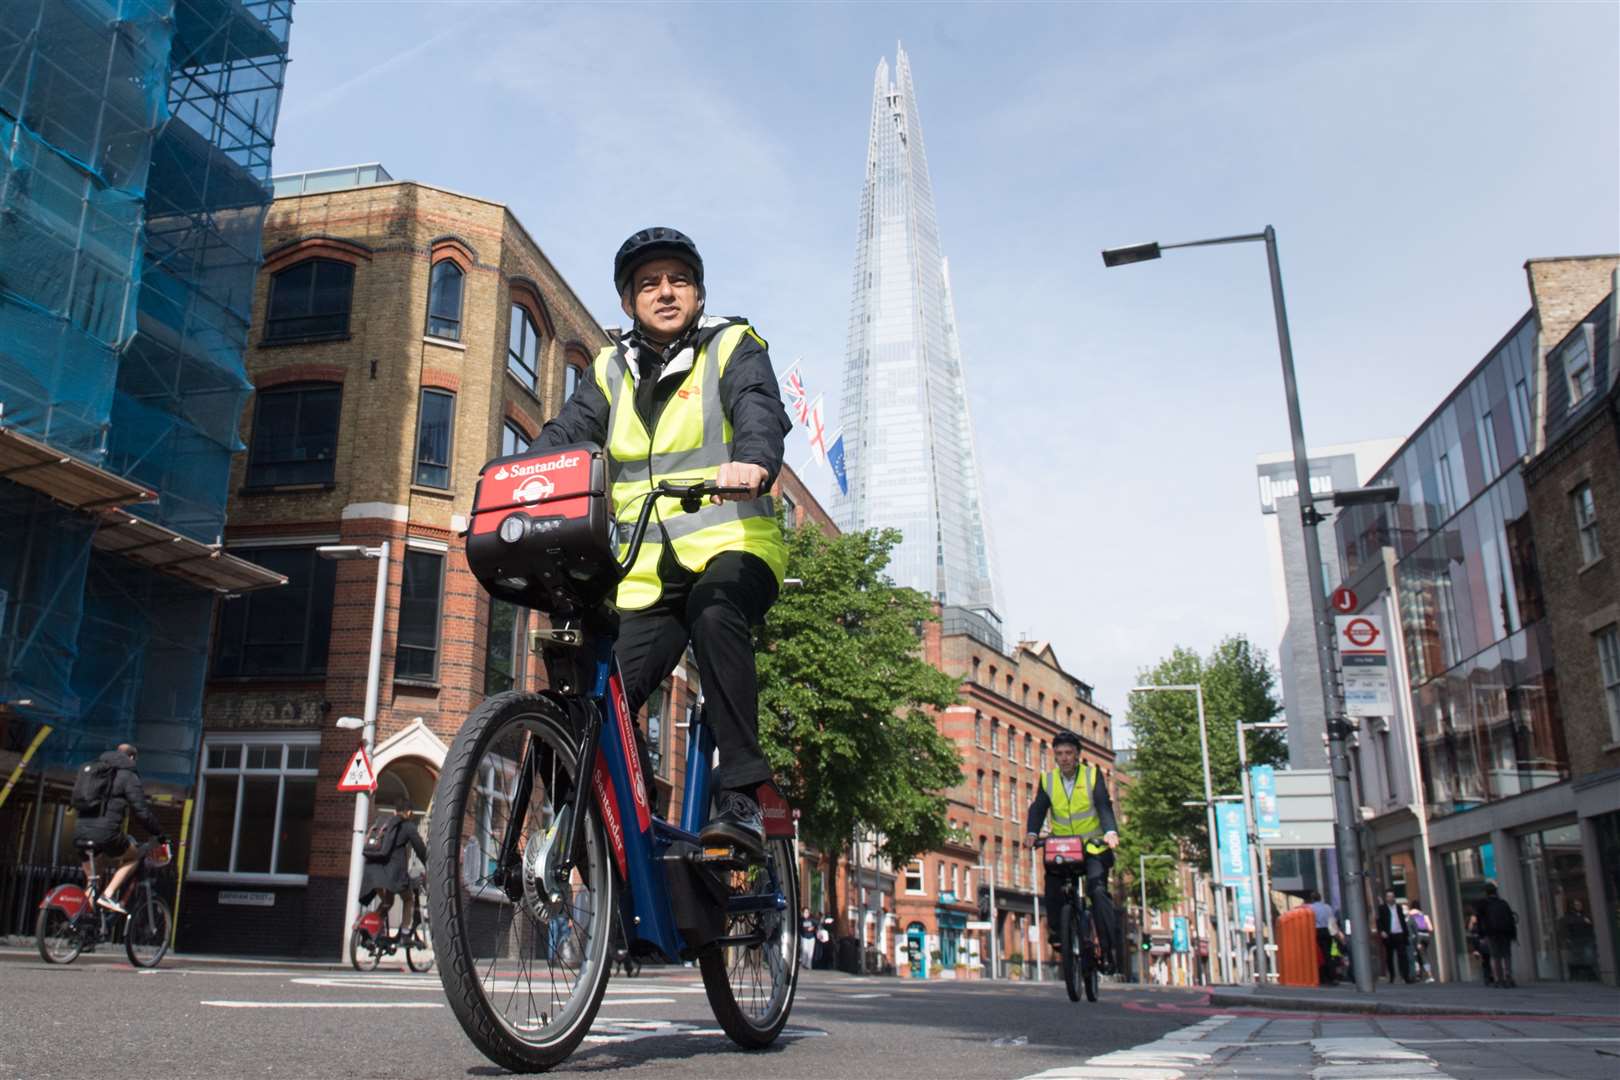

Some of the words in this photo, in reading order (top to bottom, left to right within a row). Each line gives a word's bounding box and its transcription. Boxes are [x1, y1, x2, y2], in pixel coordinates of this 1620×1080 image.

[510, 455, 580, 478] Santander
[1340, 591, 1350, 609] J
[593, 768, 622, 851] Santander
[1229, 831, 1243, 873] LONDON
